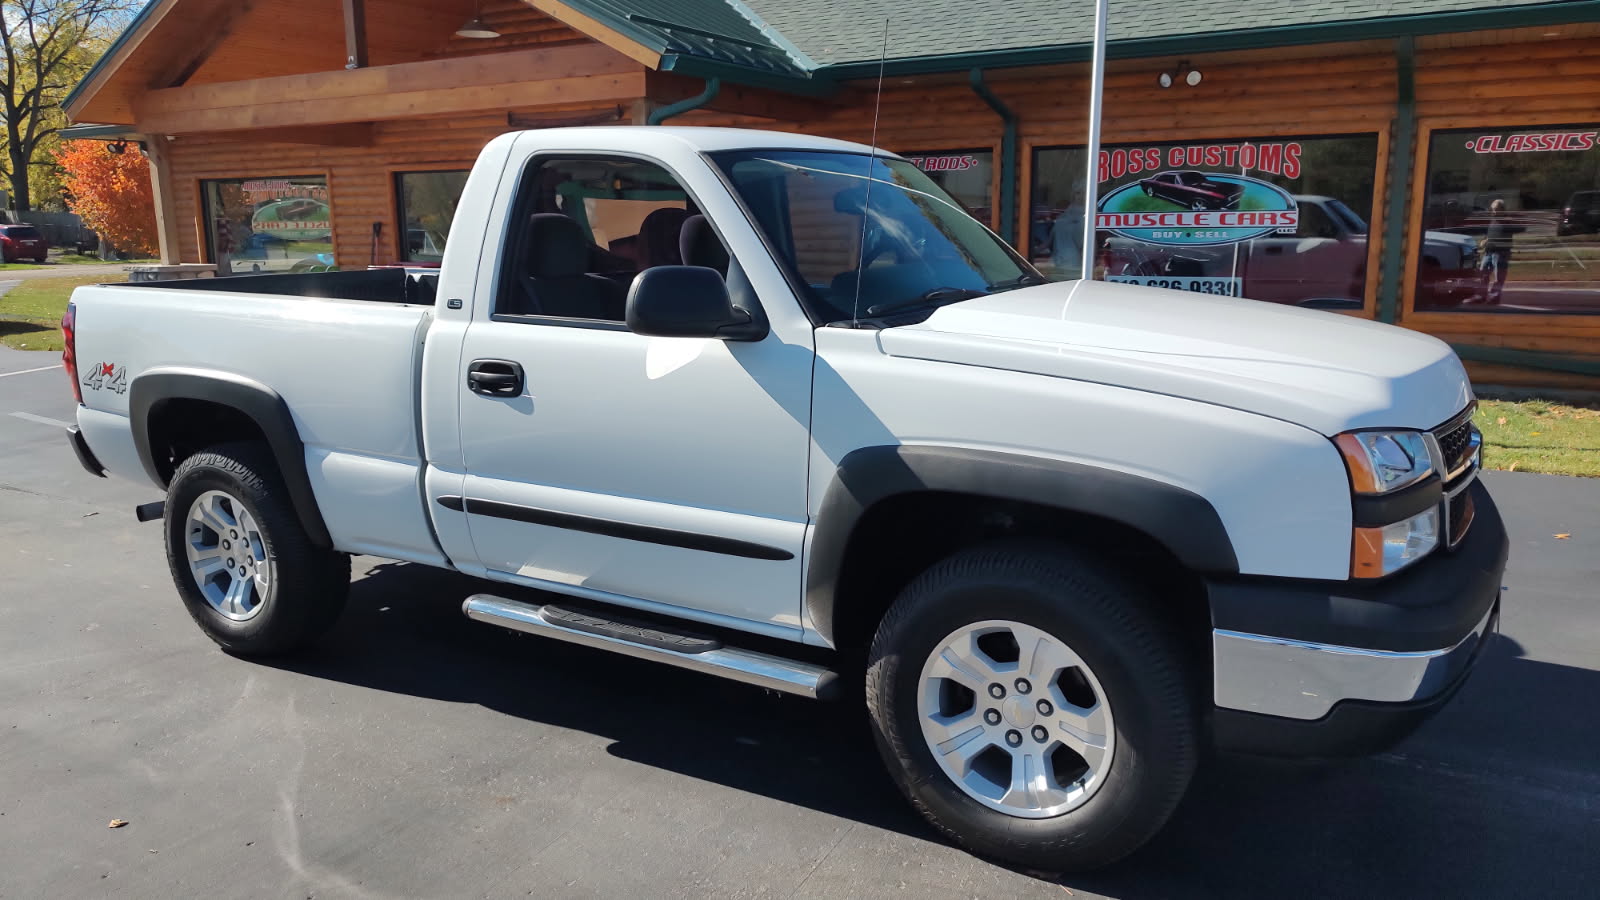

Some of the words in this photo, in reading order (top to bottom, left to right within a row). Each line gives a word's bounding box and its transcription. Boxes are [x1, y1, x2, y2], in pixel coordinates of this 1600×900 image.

[1475, 132, 1598, 153] CLASSICS
[924, 156, 973, 171] RODS
[1168, 144, 1302, 179] CUSTOMS
[1096, 213, 1211, 226] MUSCLE
[1219, 212, 1297, 226] CARS
[1152, 231, 1183, 239] BUY
[1194, 231, 1230, 239] SELL
